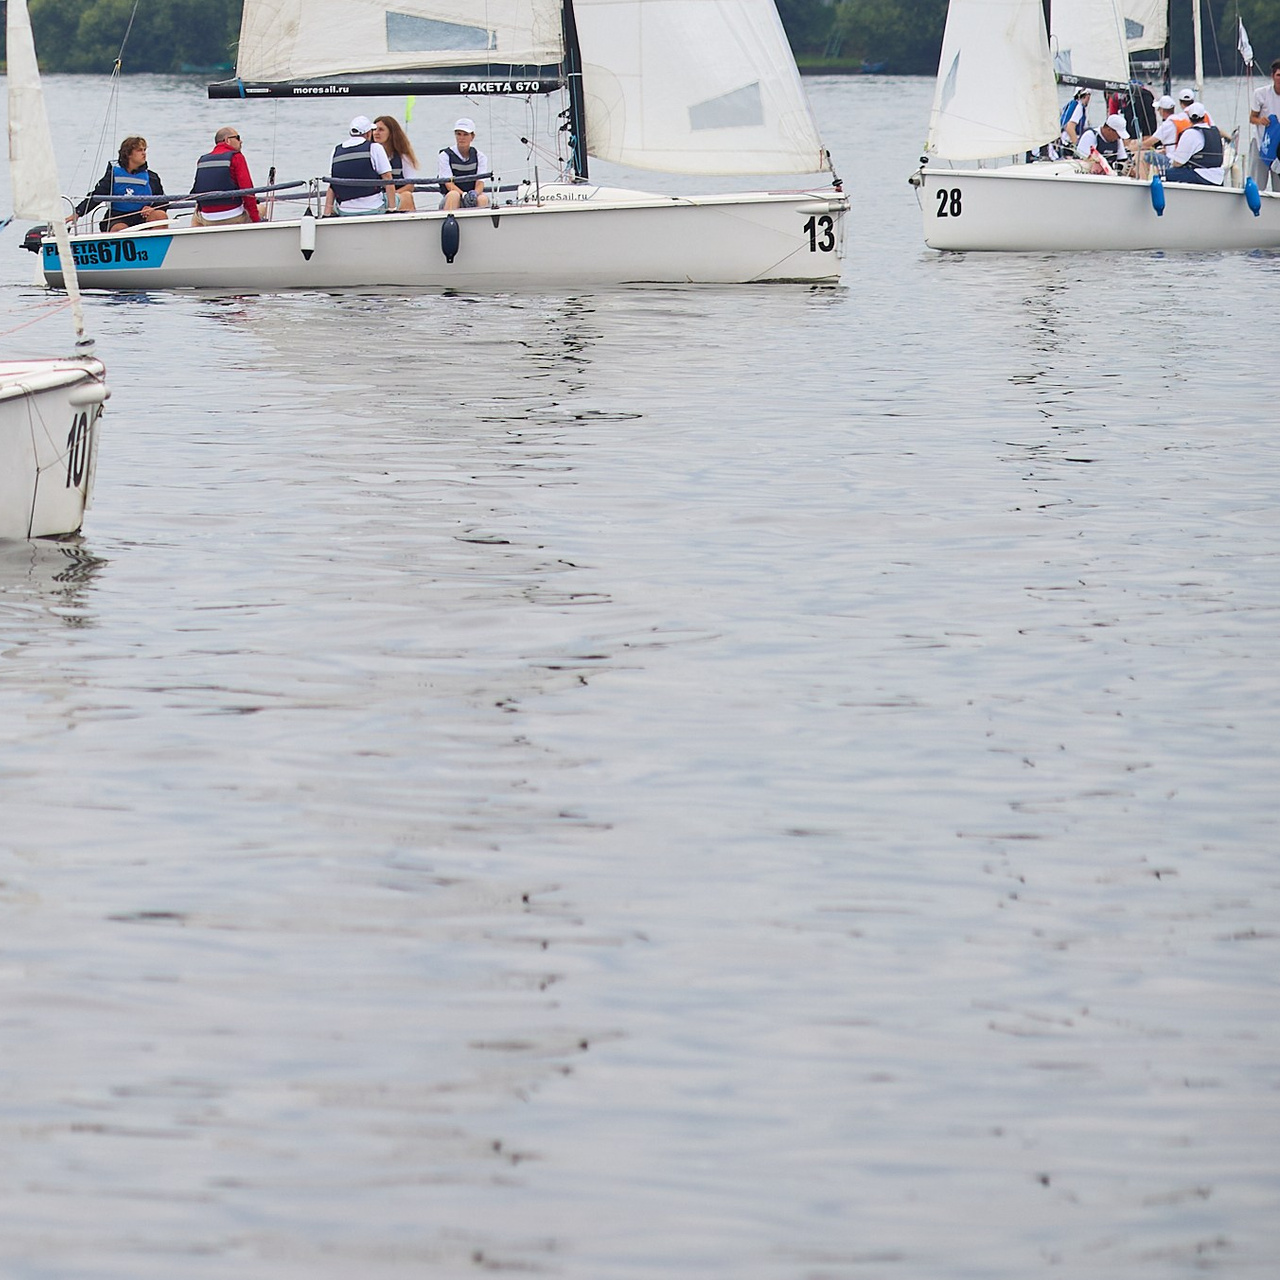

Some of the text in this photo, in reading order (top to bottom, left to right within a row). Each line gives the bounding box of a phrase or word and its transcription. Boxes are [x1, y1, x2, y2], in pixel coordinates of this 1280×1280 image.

[293, 86, 350, 94] moresail.ru
[515, 81, 540, 92] 670
[936, 188, 963, 218] 28
[803, 215, 835, 253] 13
[98, 240, 149, 264] 670 13
[66, 412, 88, 489] 10
